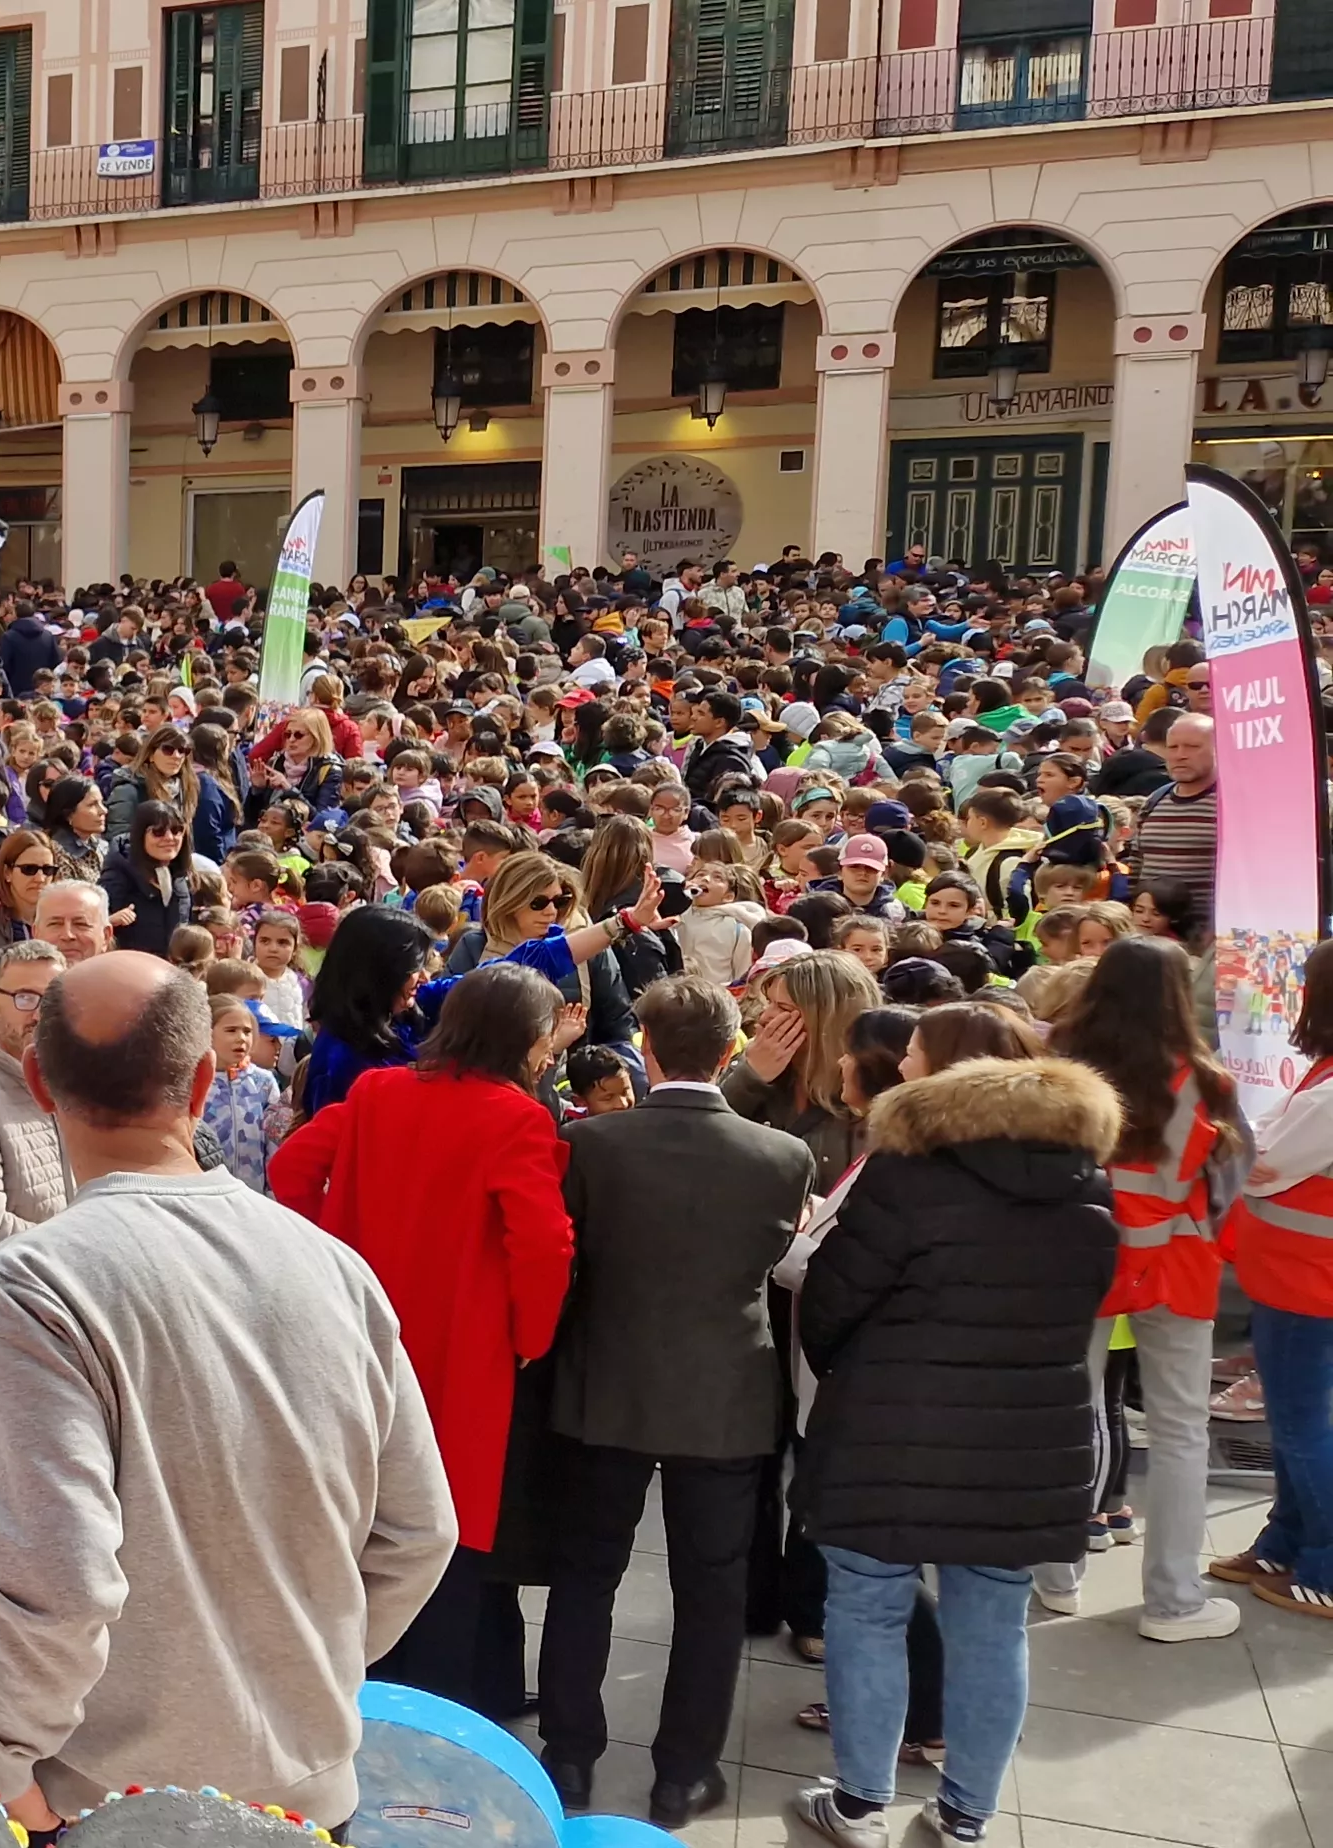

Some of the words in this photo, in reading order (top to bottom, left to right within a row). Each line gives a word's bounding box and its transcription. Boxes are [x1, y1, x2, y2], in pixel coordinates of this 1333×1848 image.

[99, 163, 111, 172] SE
[115, 158, 151, 171] VENDE
[965, 385, 1115, 421] ULRAMARINO
[660, 481, 679, 508] LA
[622, 506, 717, 533] TRASTIENDA
[1144, 538, 1189, 553] MINI
